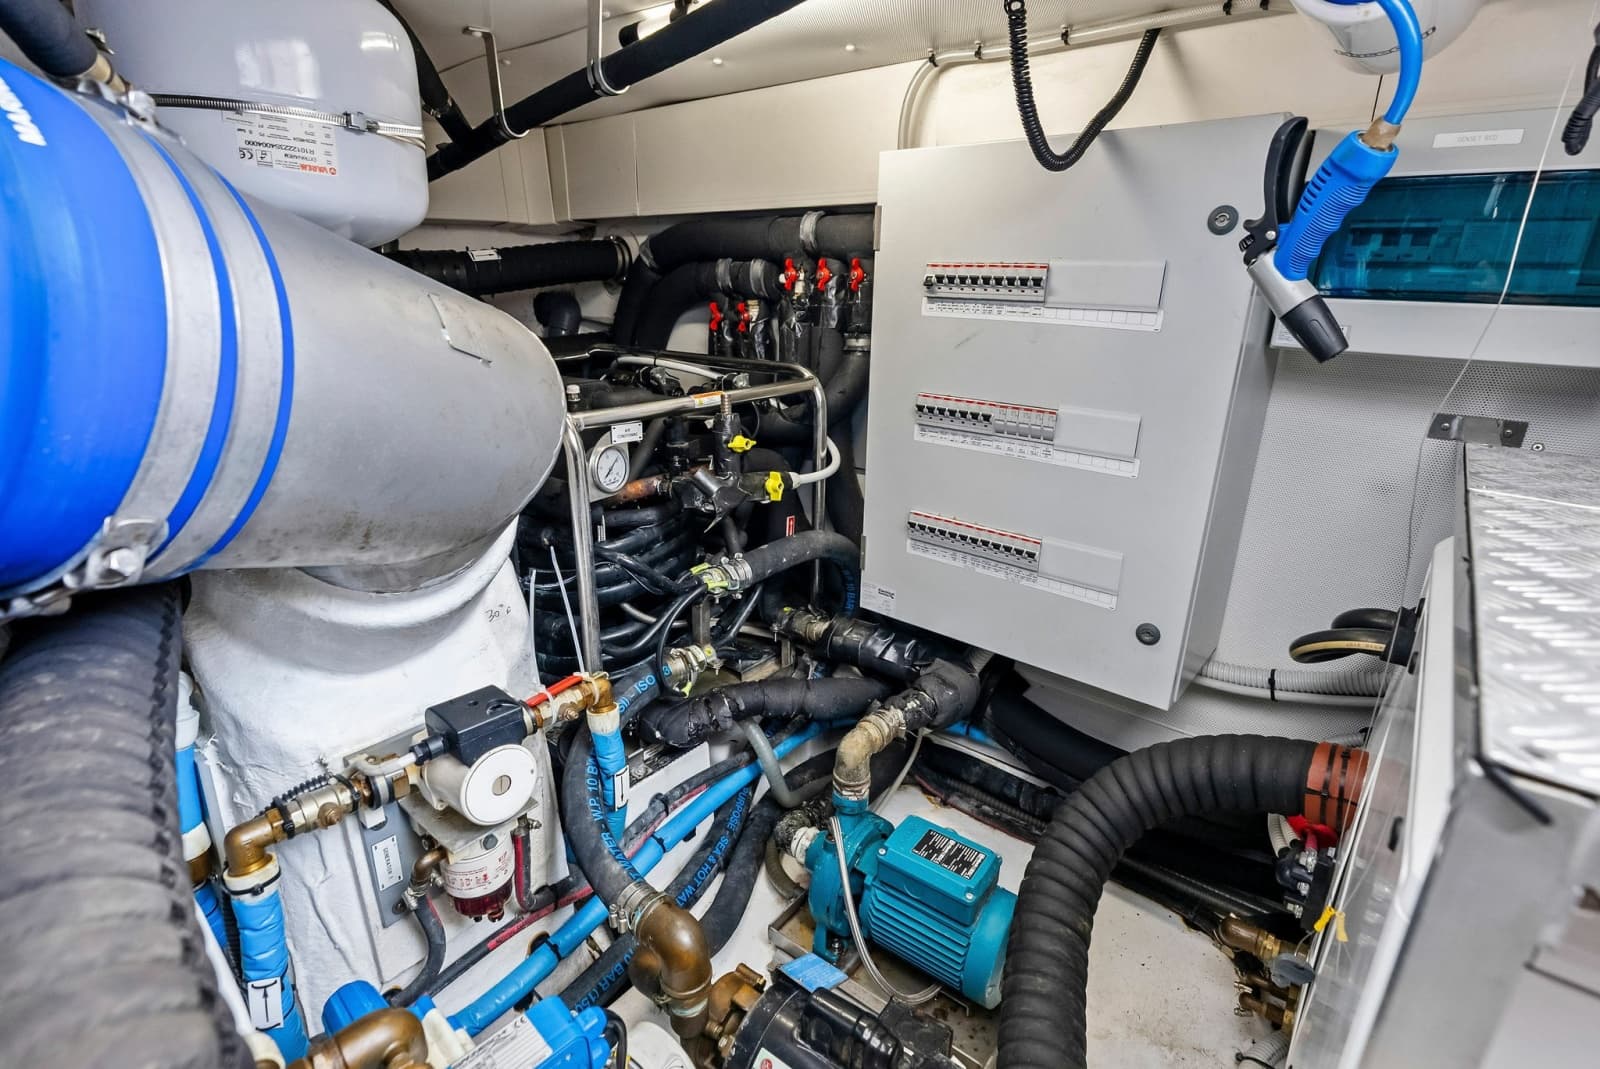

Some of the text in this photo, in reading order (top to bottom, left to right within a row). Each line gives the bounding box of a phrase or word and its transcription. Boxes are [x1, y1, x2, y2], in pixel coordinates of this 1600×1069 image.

[634, 674, 656, 694] ISO
[587, 778, 599, 792] 10
[727, 787, 750, 832] PURPOSE
[601, 832, 633, 871] WATER
[712, 835, 729, 856] SEA
[707, 855, 717, 864] &
[693, 864, 713, 887] HOT
[599, 962, 625, 992] BAR
